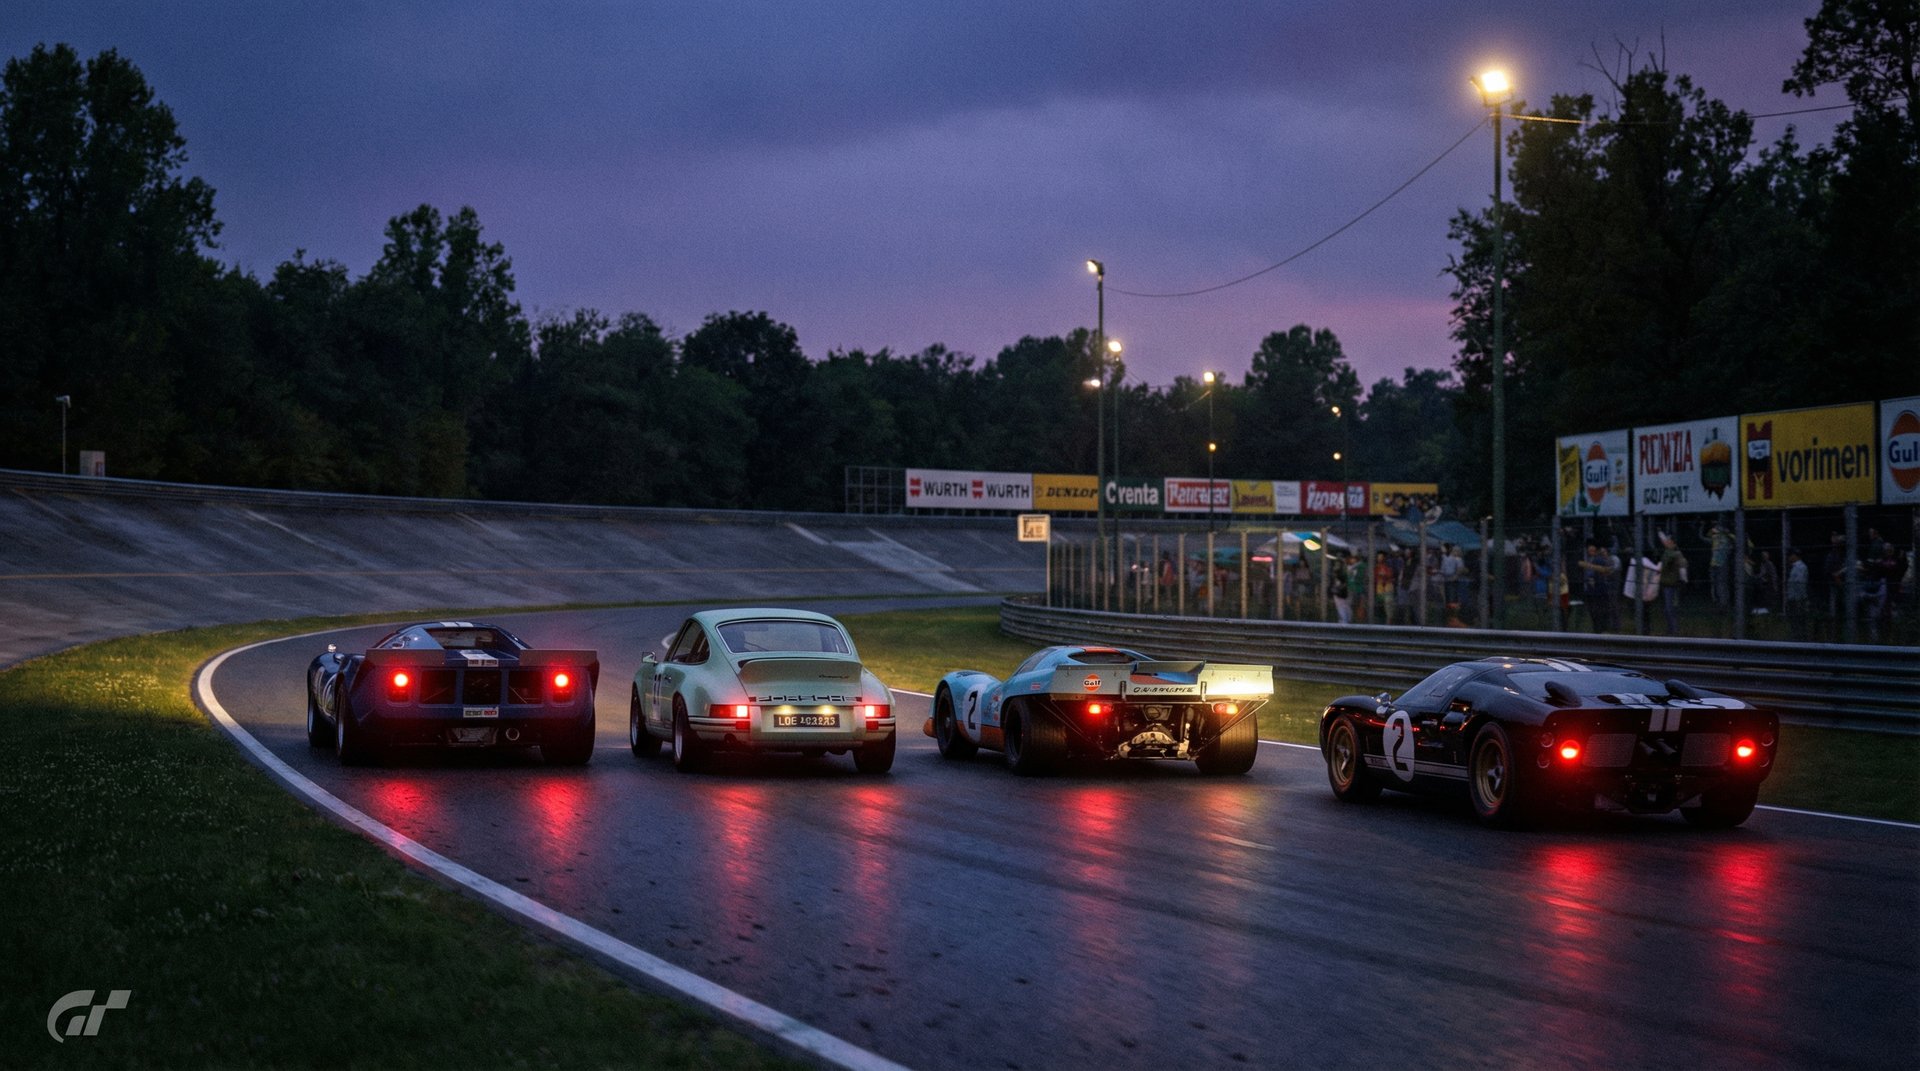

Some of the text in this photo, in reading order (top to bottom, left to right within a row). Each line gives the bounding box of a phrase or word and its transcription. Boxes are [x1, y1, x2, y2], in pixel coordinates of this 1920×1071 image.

[1777, 437, 1870, 483] vorimen
[1889, 441, 1920, 463] Gul
[1585, 464, 1608, 483] Gulf
[968, 690, 979, 731] 2
[1392, 717, 1409, 772] 2
